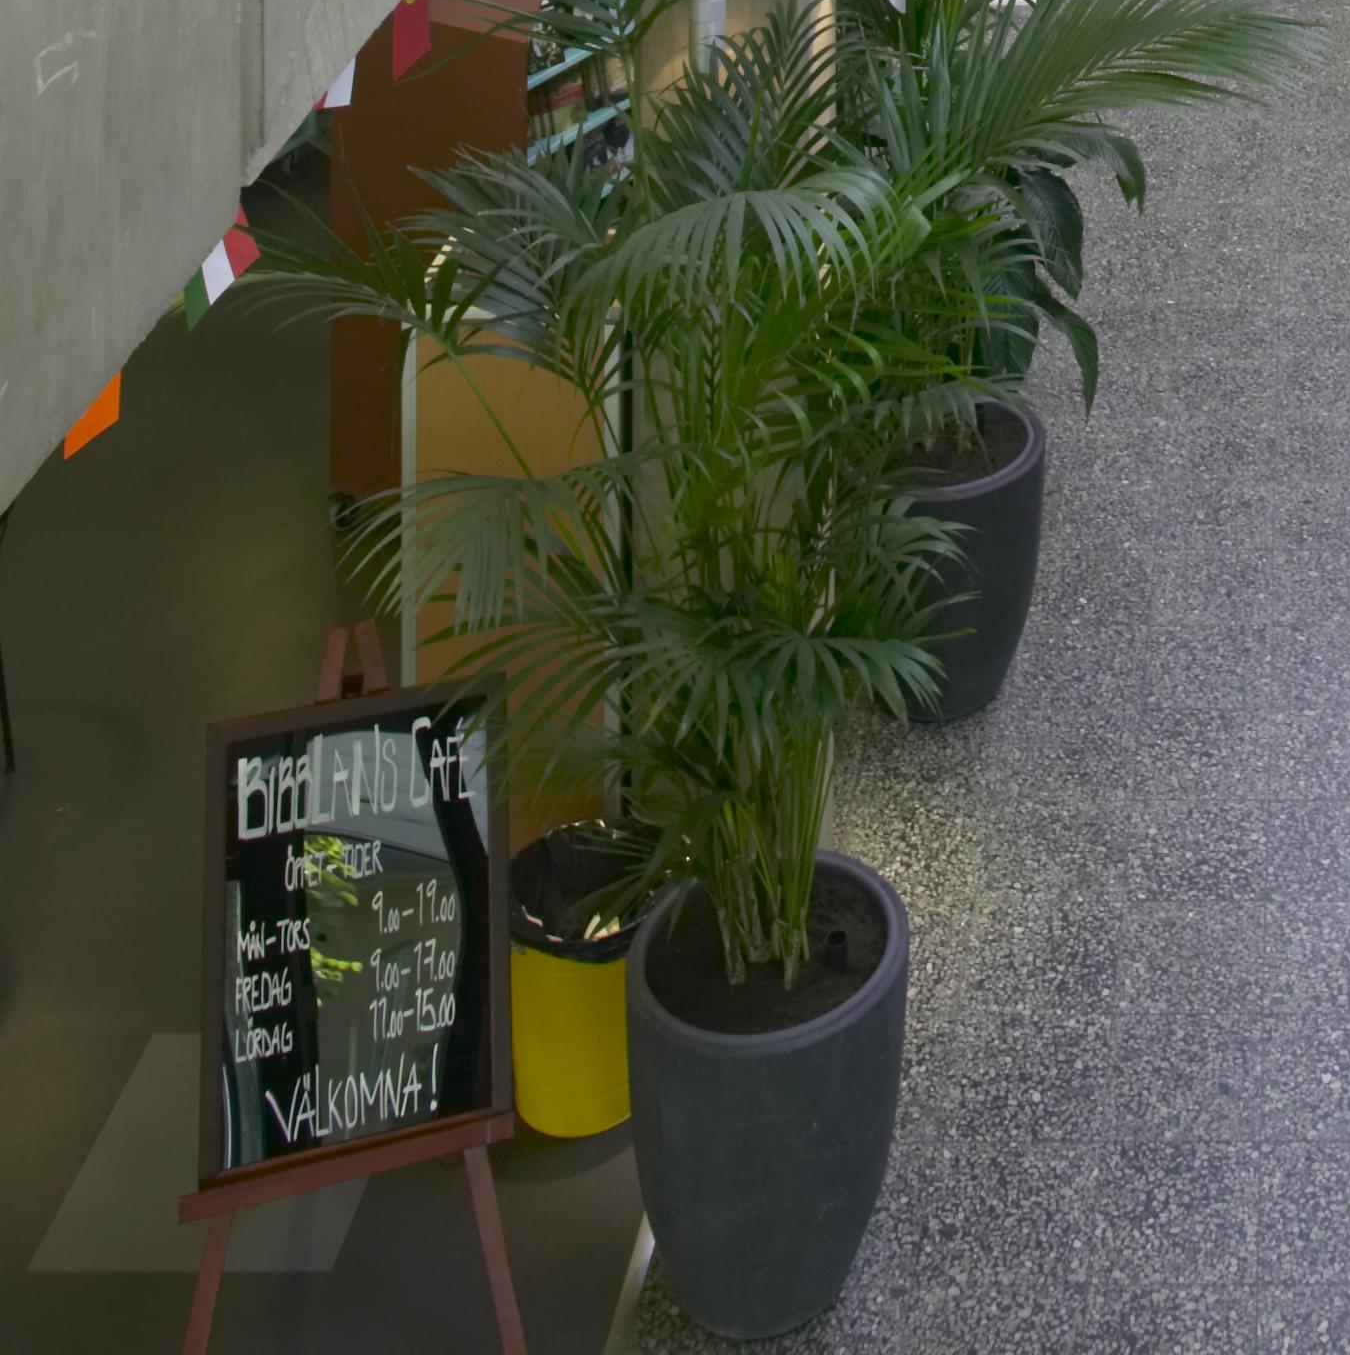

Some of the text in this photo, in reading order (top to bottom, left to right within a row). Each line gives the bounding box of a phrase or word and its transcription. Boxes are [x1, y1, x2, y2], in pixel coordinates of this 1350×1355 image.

[237, 715, 477, 841] BIBBLANS CAFÉ
[236, 917, 311, 963] MÅN-TORS
[235, 967, 293, 1016] FREDAG
[235, 1017, 294, 1063] LÖRDAG
